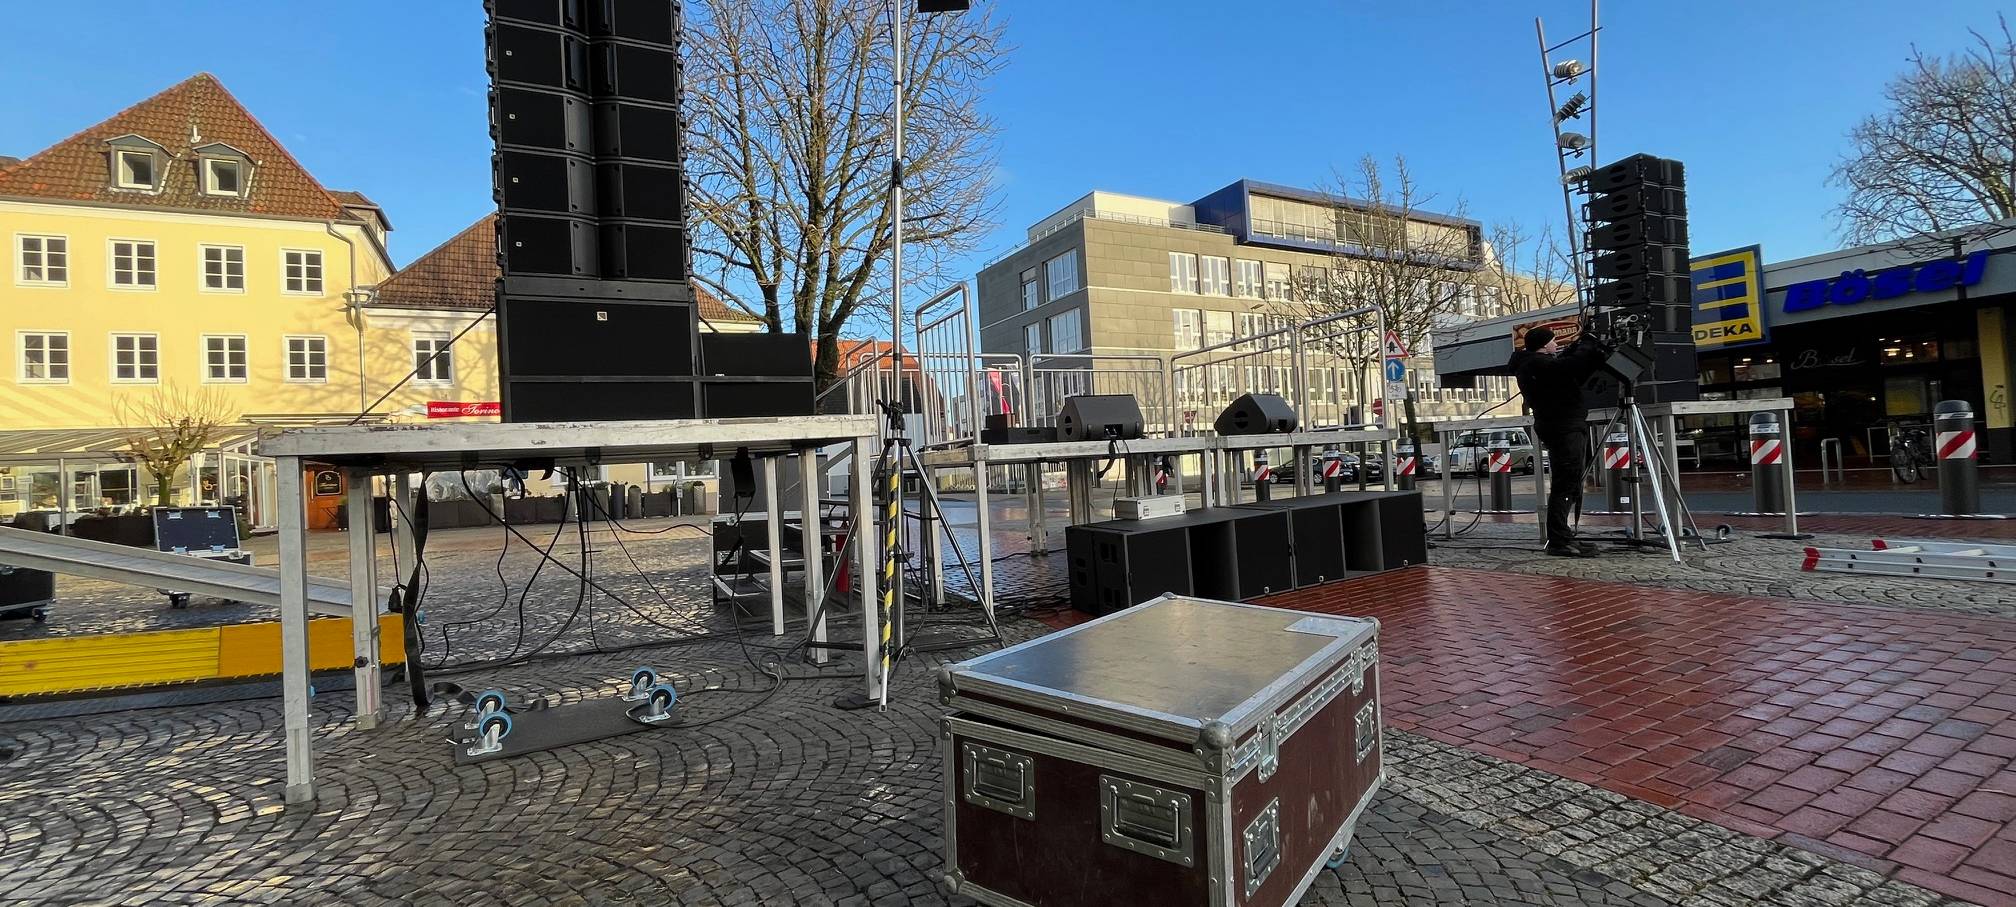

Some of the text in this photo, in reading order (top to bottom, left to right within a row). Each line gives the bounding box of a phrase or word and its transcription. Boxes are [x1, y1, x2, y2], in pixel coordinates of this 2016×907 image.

[1783, 250, 1989, 313] Bösel
[1691, 323, 1753, 342] DEKA
[1790, 347, 1857, 370] Bsel
[461, 403, 501, 415] Torino
